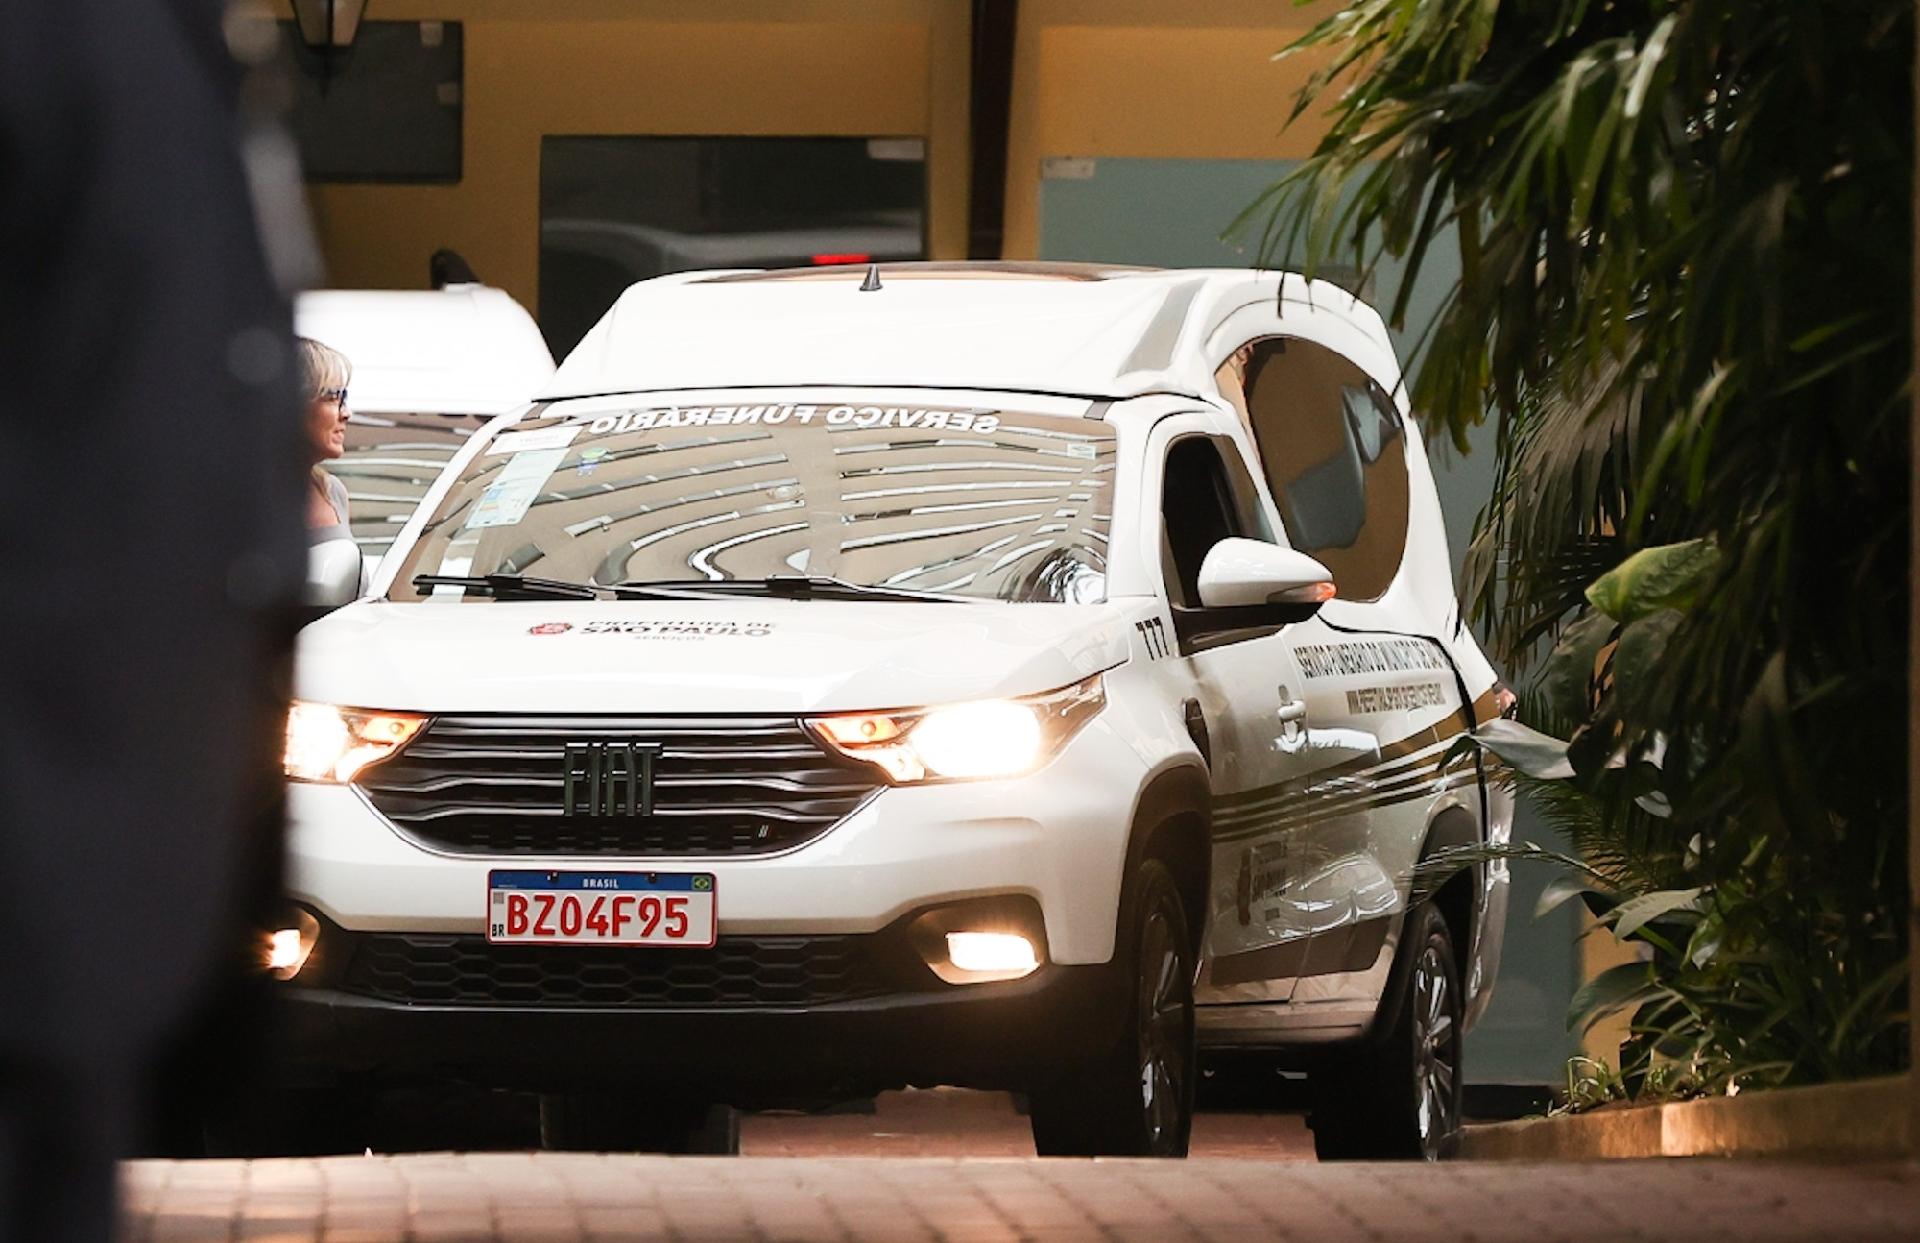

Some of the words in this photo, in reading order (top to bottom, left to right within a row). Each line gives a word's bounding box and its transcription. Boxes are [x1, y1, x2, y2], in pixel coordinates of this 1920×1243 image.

[659, 626, 771, 636] PAULO
[1135, 616, 1169, 661] 777
[564, 741, 664, 817] FIAT
[582, 877, 619, 890] BRASIL
[491, 923, 505, 937] BR
